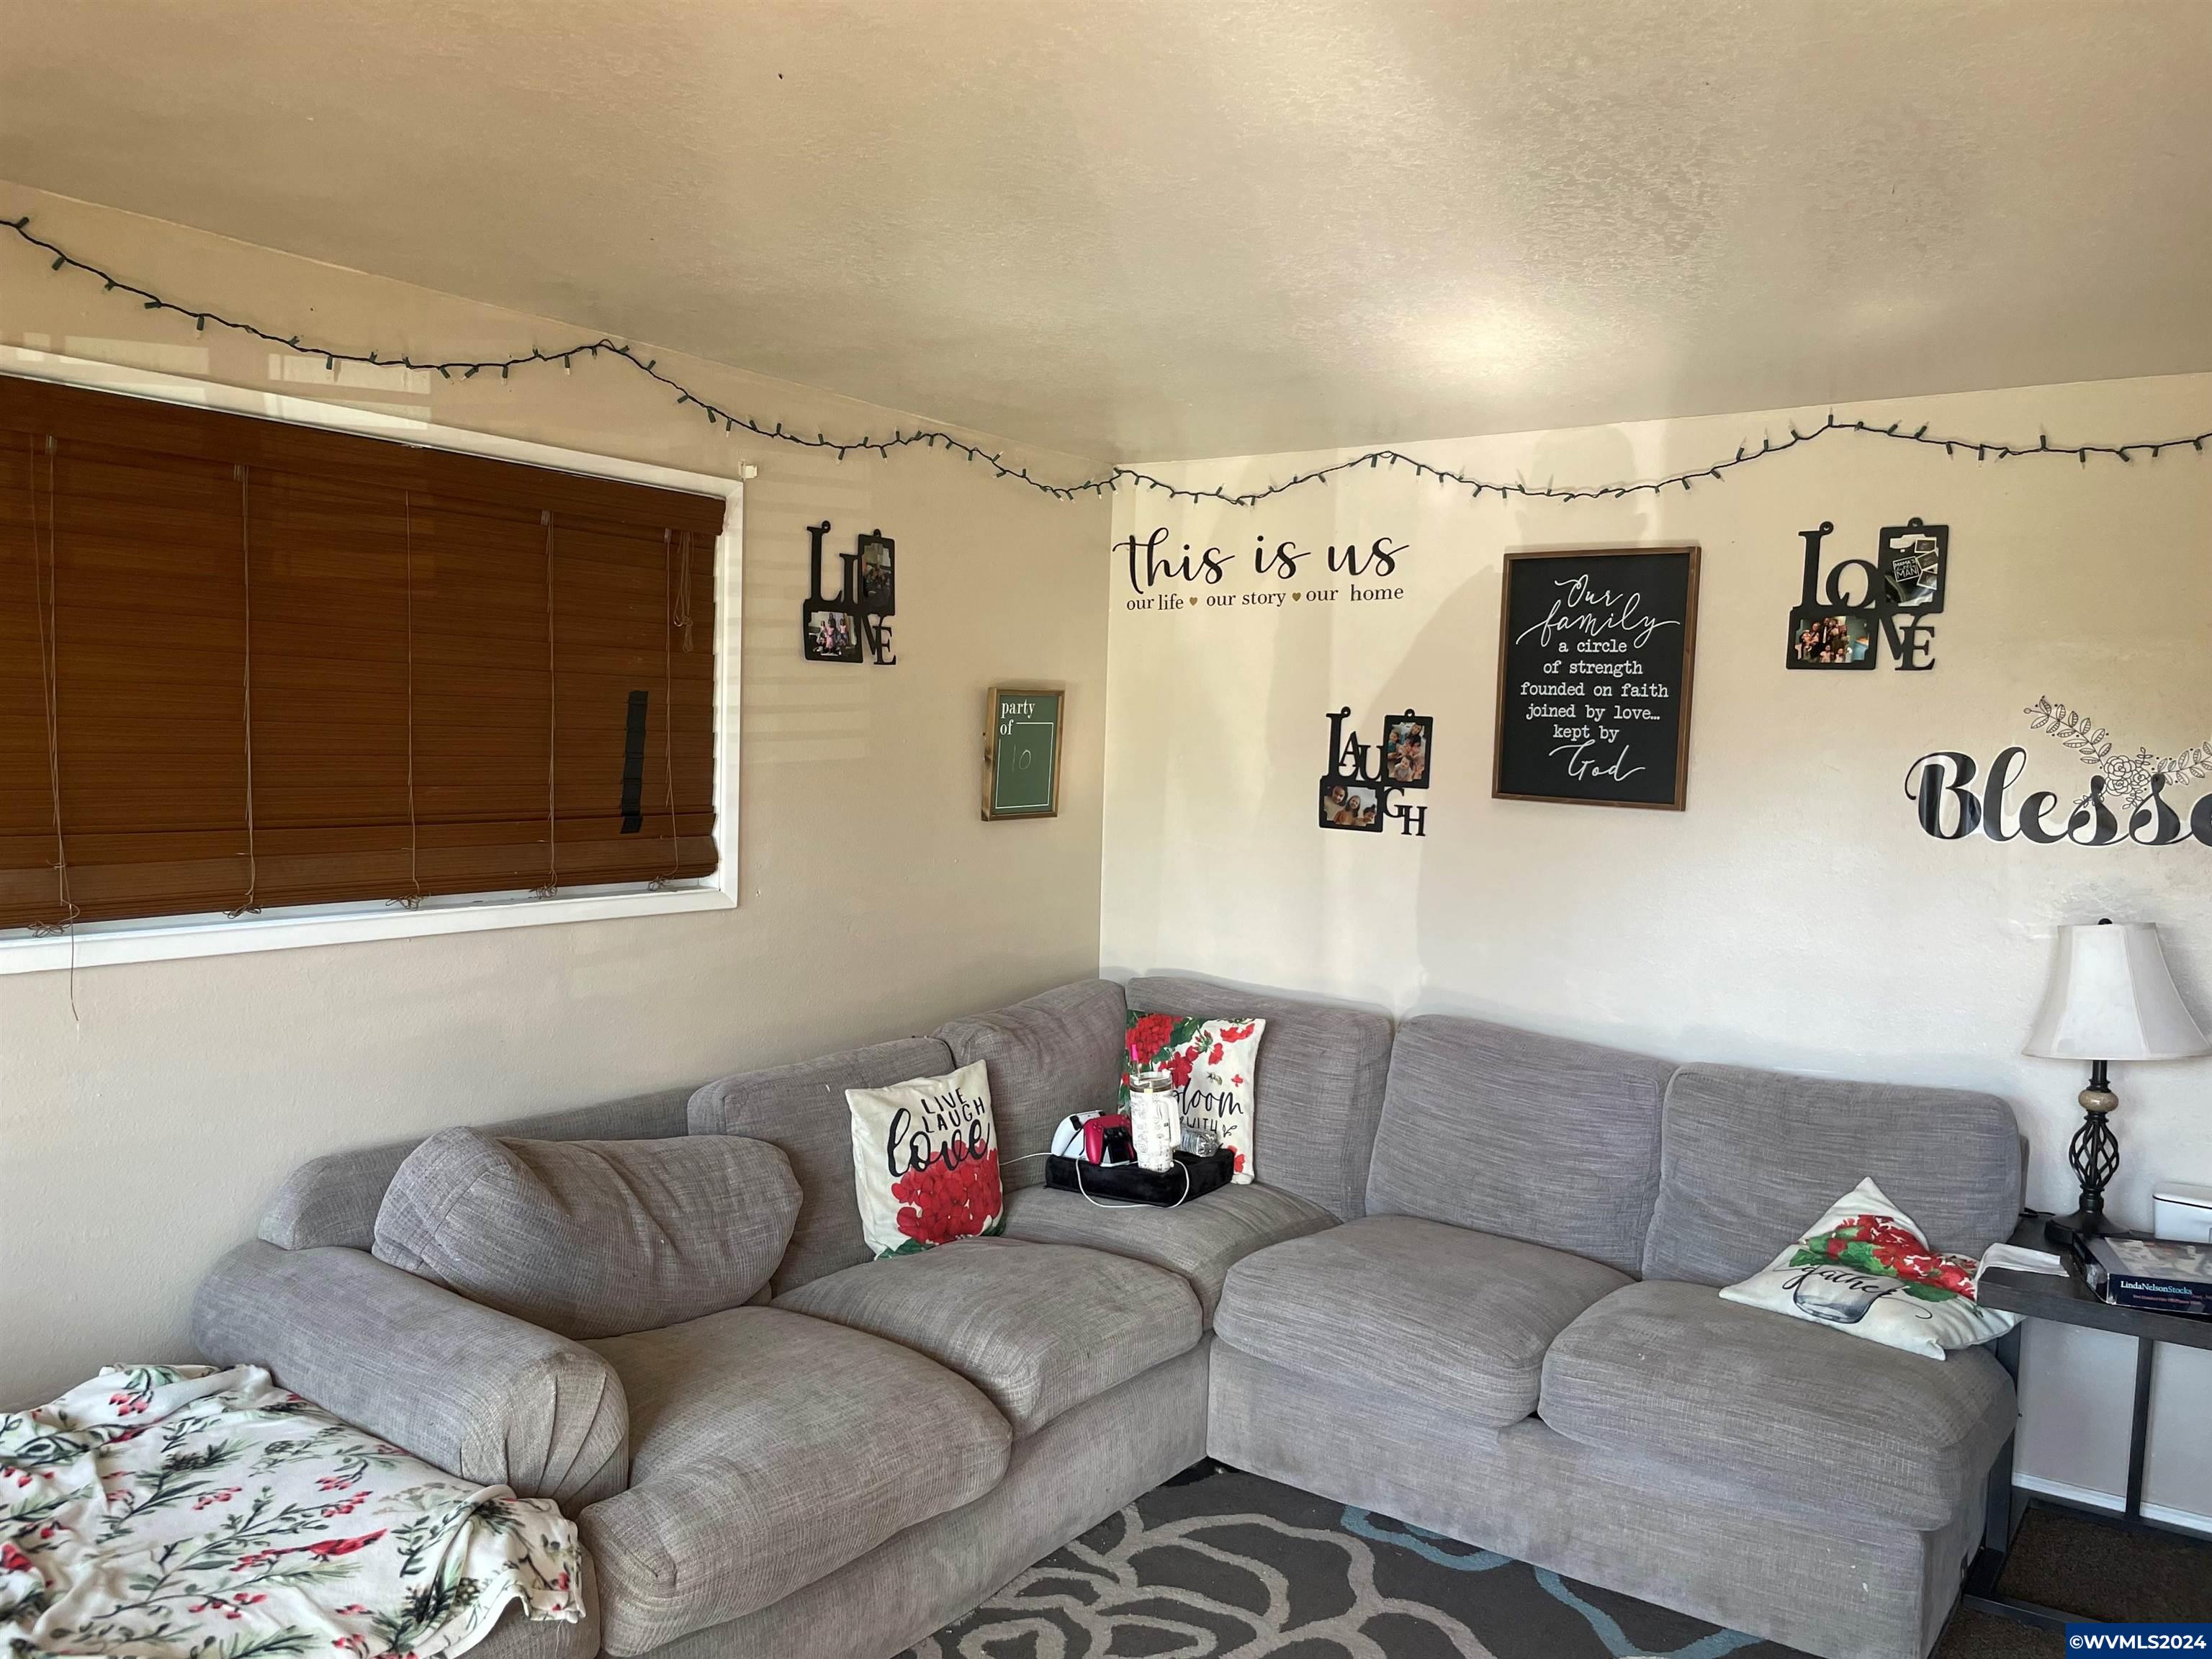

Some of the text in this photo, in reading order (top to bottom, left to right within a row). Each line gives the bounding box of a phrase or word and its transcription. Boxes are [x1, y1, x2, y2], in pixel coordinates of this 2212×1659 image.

[1112, 527, 1410, 595] this is us
[1126, 584, 1404, 611] our life our story our home
[1555, 574, 1623, 608] Our
[1516, 593, 1681, 649] family
[1558, 639, 1627, 653] a circle
[1543, 660, 1643, 678] of strength
[1520, 682, 1669, 698] founded on faith
[1001, 698, 1035, 719] party
[1526, 703, 1660, 722] joined by love...
[999, 719, 1015, 736] of
[1553, 724, 1620, 743] kept by
[1549, 739, 1646, 782] God
[921, 1087, 966, 1114] LIVE
[1172, 1077, 1244, 1118] loom
[922, 1097, 986, 1133] LAUGH
[1187, 1116, 1218, 1134] WITH
[887, 1107, 991, 1177] love
[2120, 1280, 2193, 1295] LindaNelsonStocks
